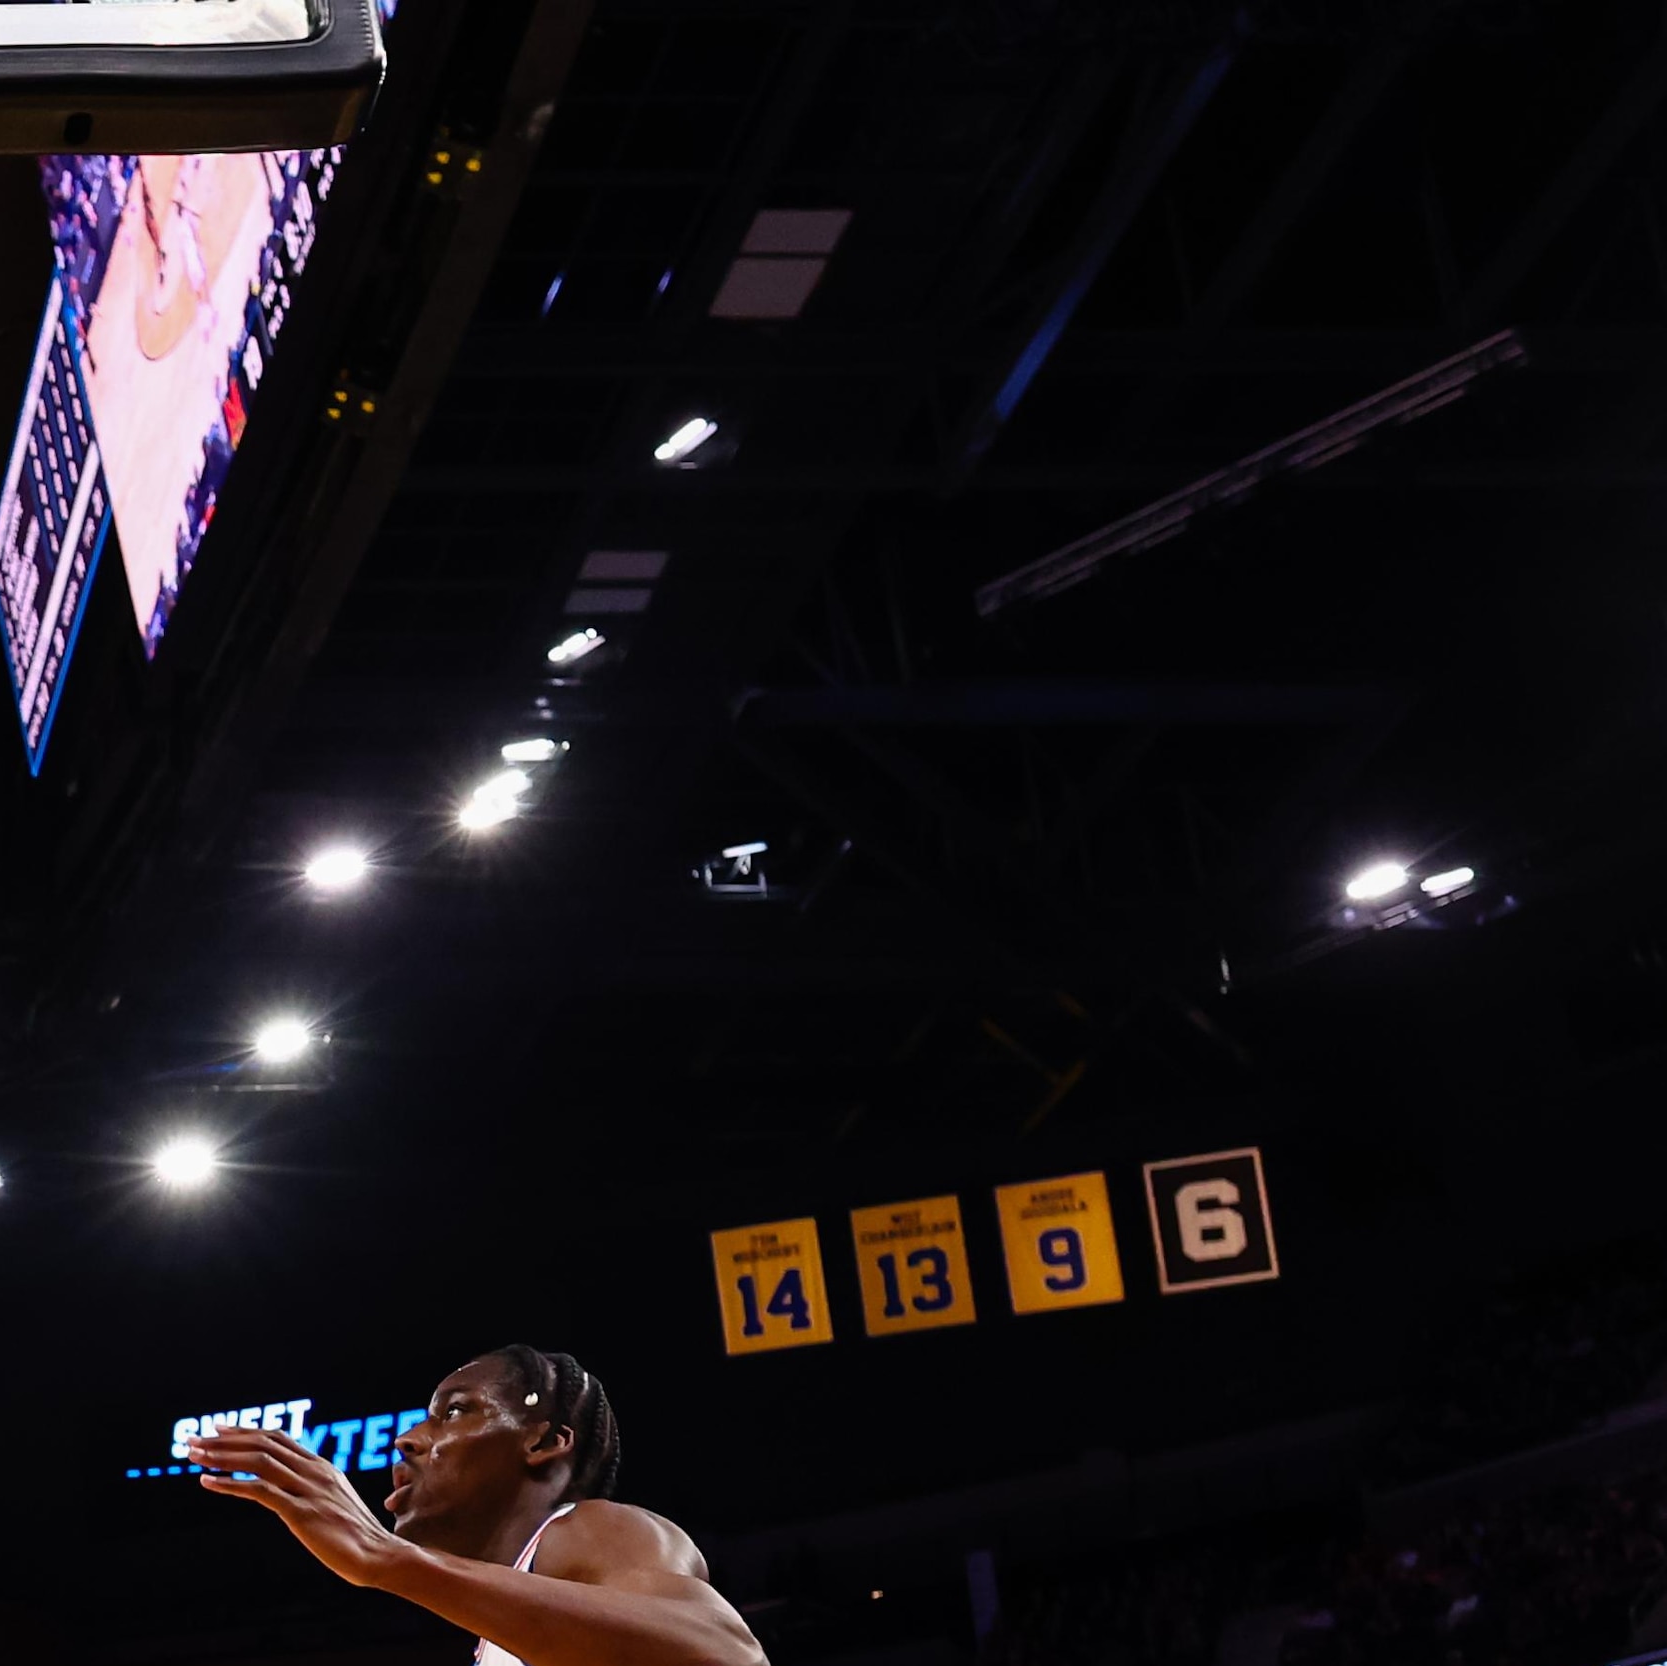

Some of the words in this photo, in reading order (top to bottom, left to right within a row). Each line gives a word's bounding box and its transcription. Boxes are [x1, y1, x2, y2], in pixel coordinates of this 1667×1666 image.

[1174, 1178, 1248, 1262] 6
[877, 1246, 955, 1319] 13
[1037, 1226, 1088, 1292] 9
[737, 1268, 812, 1337] 14
